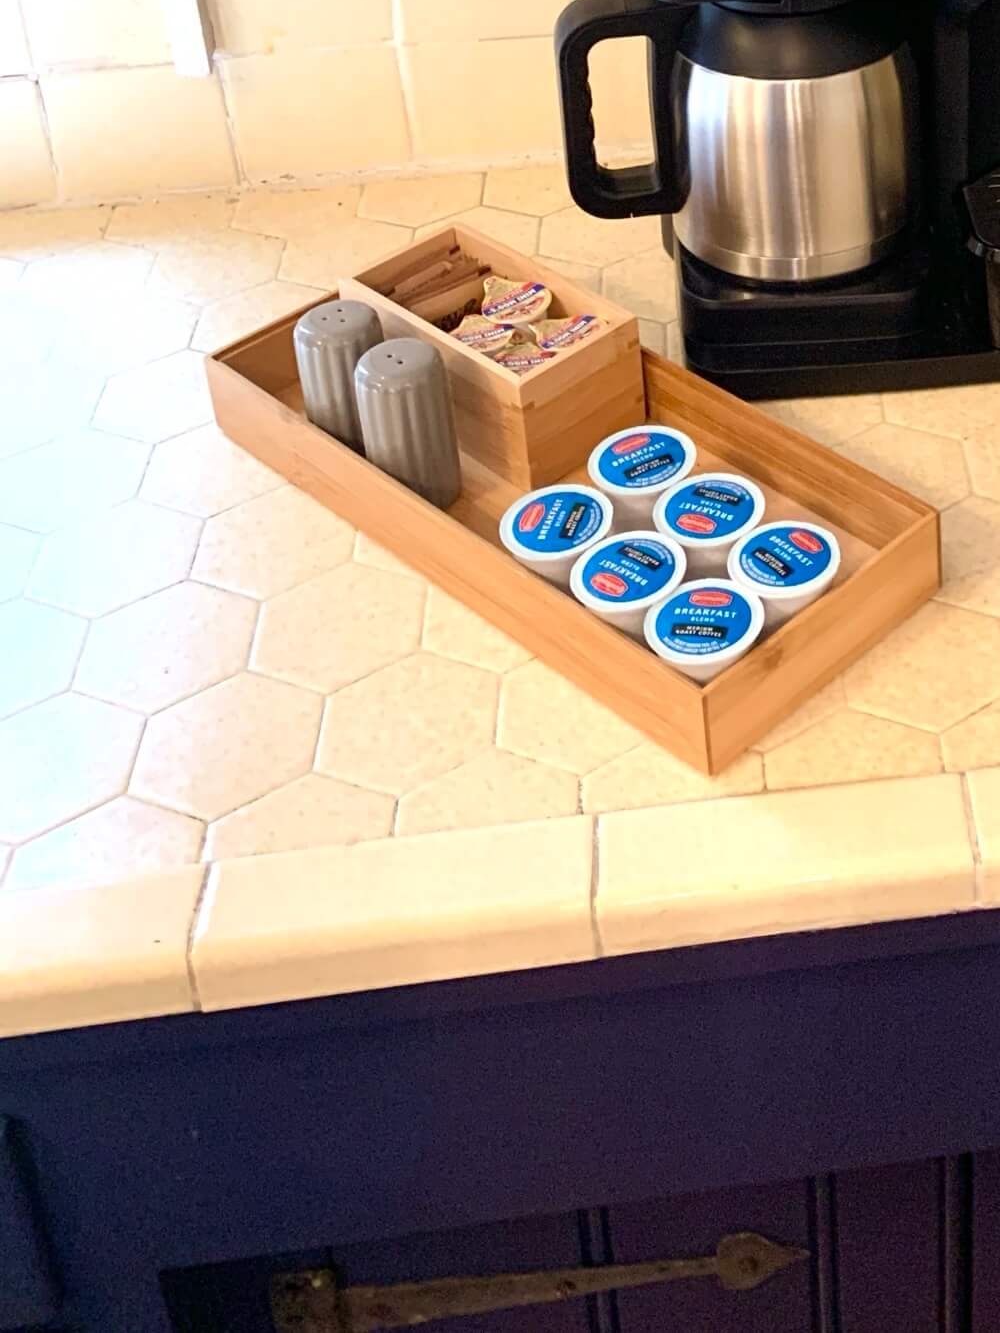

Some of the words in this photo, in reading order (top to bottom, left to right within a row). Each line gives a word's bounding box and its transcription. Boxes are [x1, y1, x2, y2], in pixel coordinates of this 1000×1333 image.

[612, 442, 665, 467] BREAKFAST
[632, 453, 654, 464] BLEND
[537, 499, 563, 540] BREAKFAST
[679, 502, 734, 521] BREAKFAST
[769, 535, 814, 566] BREAKFAST
[774, 547, 791, 561] BLEND
[600, 560, 648, 586] BREAKFAST
[621, 560, 640, 570] BLEND
[674, 608, 737, 618] BREAKFAST
